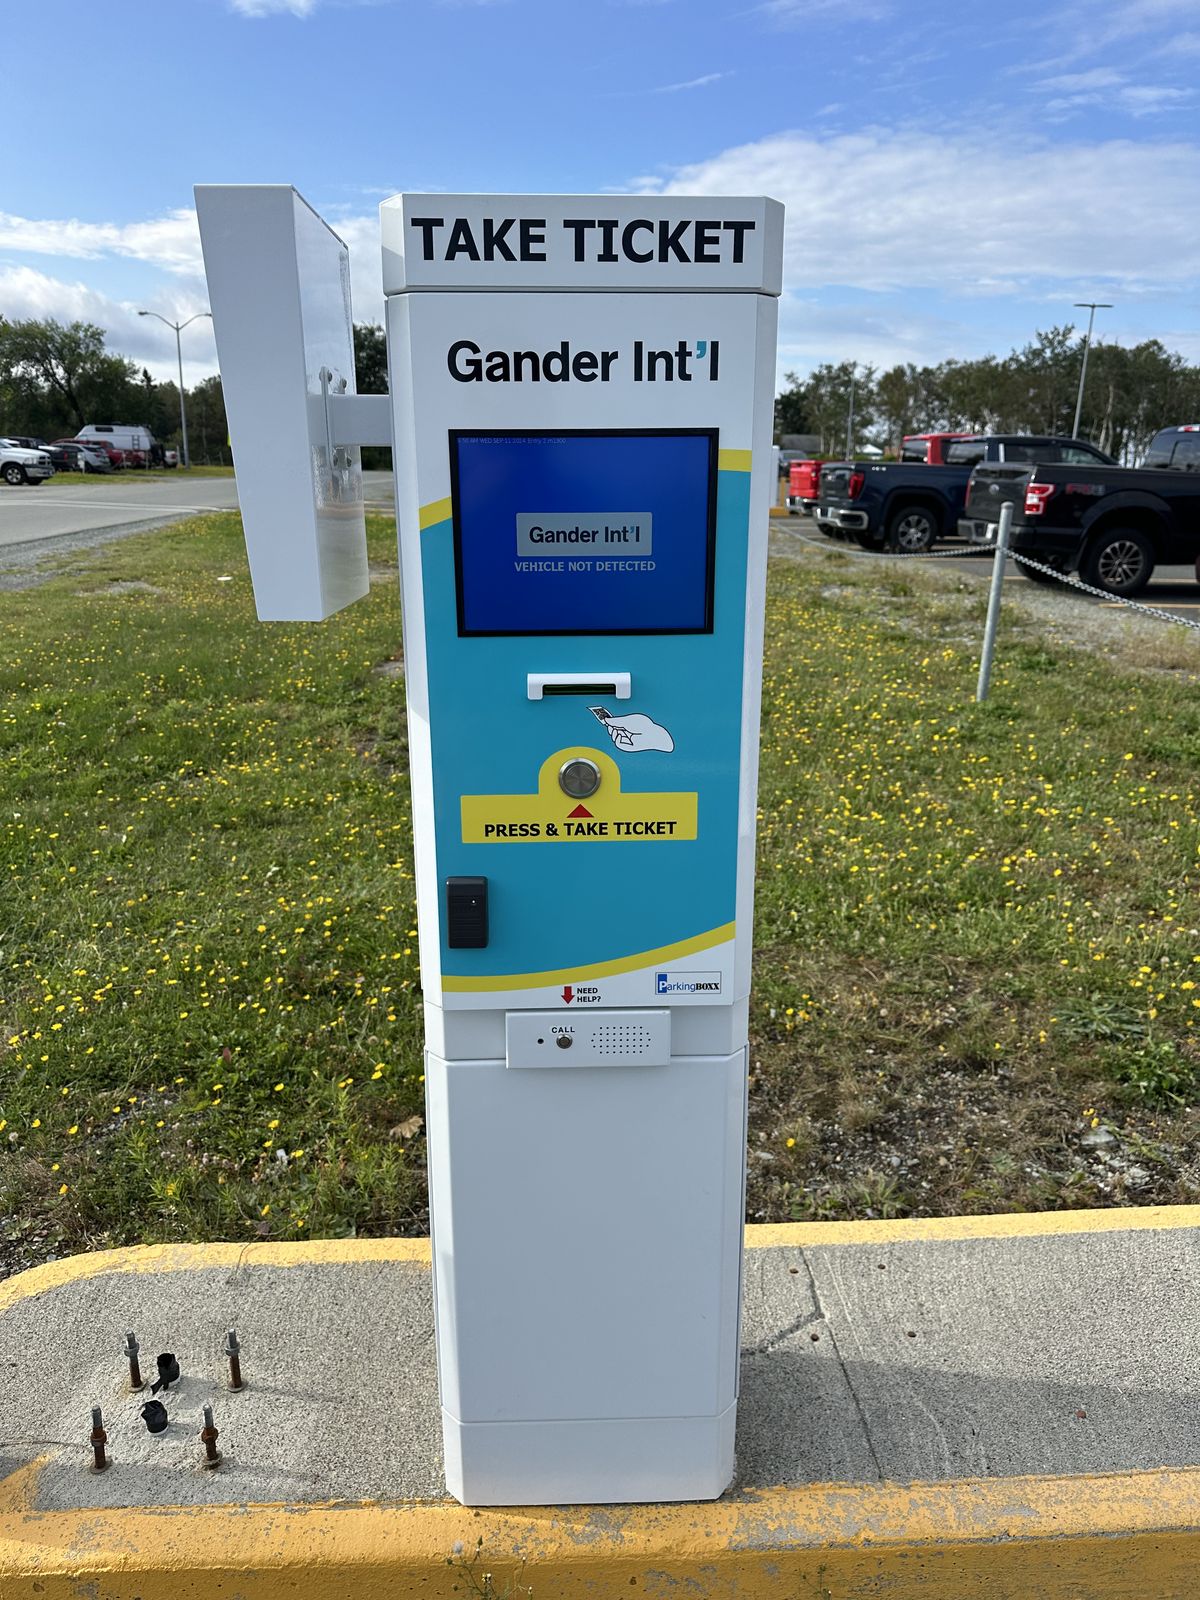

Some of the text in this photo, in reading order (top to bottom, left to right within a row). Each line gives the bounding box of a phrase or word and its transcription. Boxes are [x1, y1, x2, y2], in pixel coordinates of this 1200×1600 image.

[411, 217, 756, 263] TAKE TICKET
[447, 340, 618, 382] Gander
[529, 526, 599, 544] Gander
[514, 560, 656, 572] VEHICLE NOT DETECTED
[484, 821, 677, 838] PRESS & TAKE TICKET
[576, 995, 602, 1003] HELP?
[551, 1026, 576, 1034] CALL
